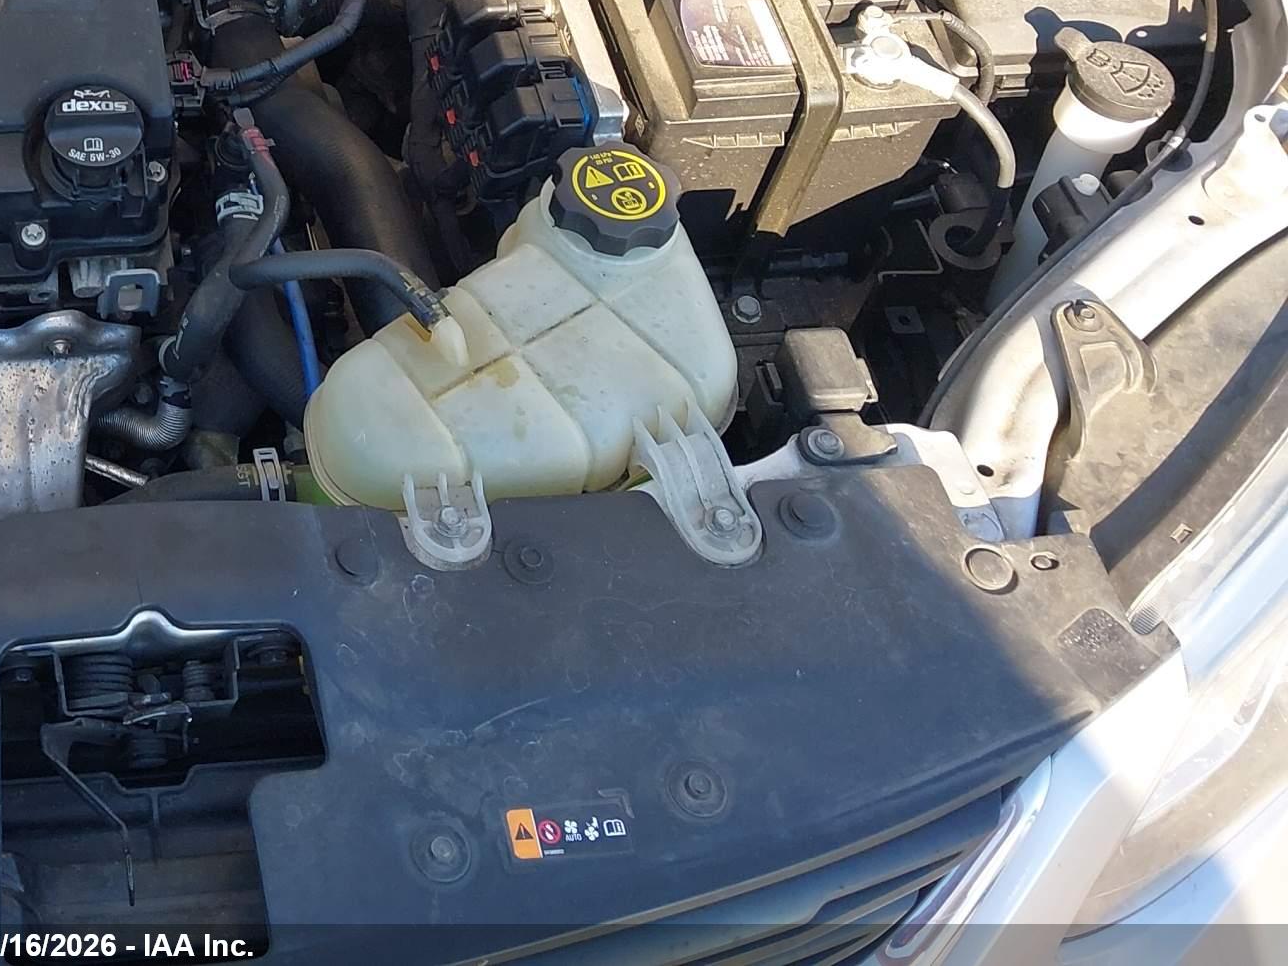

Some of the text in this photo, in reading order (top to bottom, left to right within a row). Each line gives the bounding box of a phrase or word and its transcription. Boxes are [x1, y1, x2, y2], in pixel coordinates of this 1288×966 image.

[62, 98, 128, 112] dexos
[67, 146, 122, 162] SAE 5W-30
[565, 833, 583, 842] AUTO
